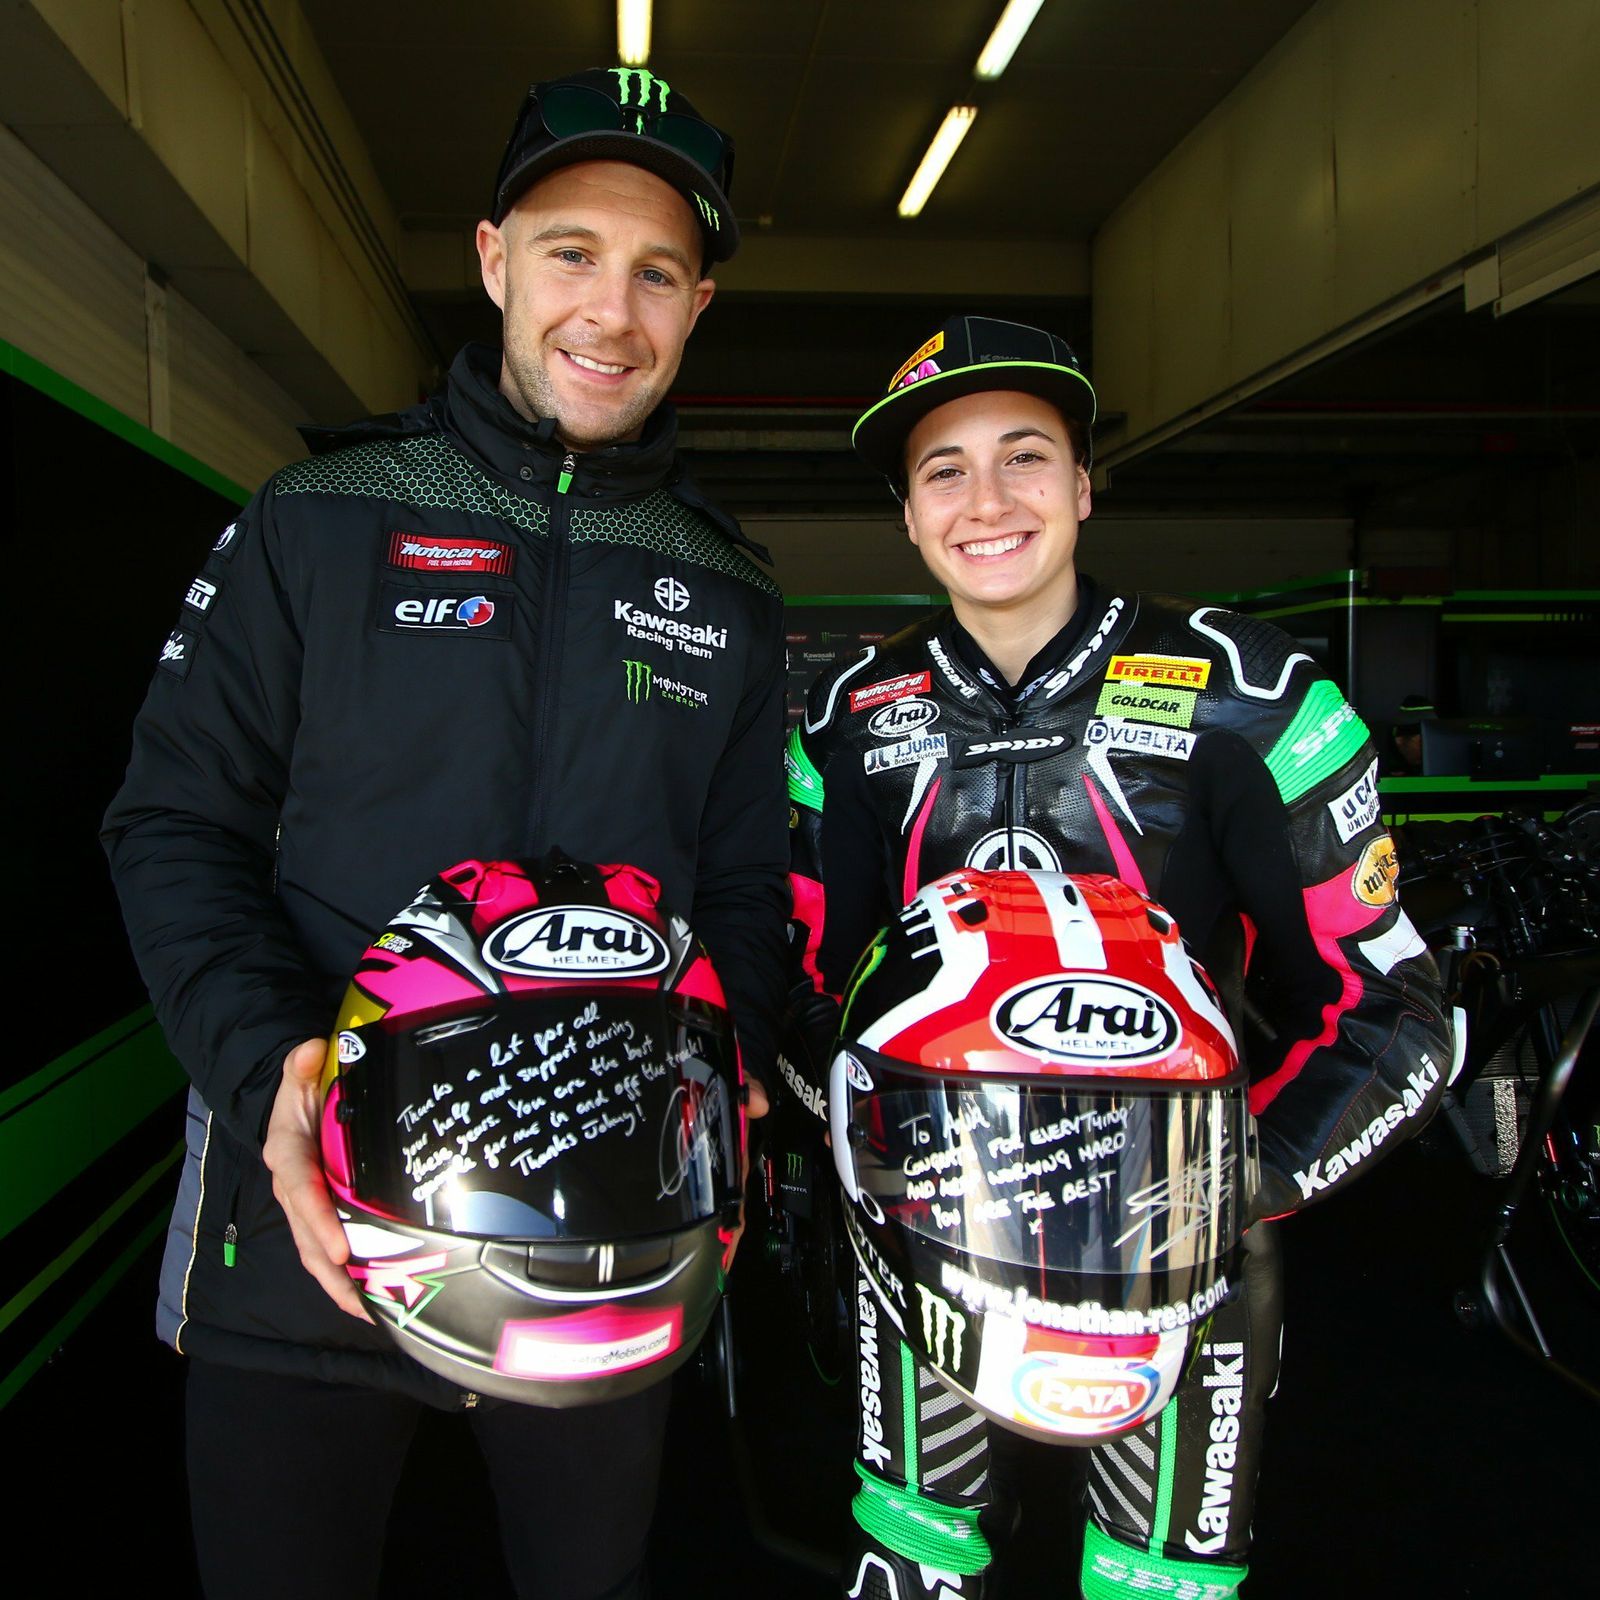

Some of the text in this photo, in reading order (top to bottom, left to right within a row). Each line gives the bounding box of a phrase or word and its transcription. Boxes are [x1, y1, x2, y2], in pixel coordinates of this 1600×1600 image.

[394, 598, 458, 625] elf
[613, 599, 728, 649] Kawasaki
[626, 623, 713, 660] Racing Team
[1112, 660, 1204, 683] PIRELLI
[652, 674, 709, 706] MONSTER
[1111, 694, 1181, 714] GOLDCAR
[872, 701, 930, 727] Arai
[964, 735, 1066, 757] SPIDI
[500, 913, 650, 963] Arai
[552, 955, 620, 966] HELMET
[573, 1000, 601, 1030] all
[1008, 987, 1162, 1039] Arai
[1060, 1039, 1129, 1050] HELMET
[479, 1073, 513, 1105] and
[516, 1035, 578, 1083] support
[585, 1020, 635, 1050] during
[775, 1052, 828, 1123] wasak
[1292, 1052, 1441, 1201] Kawasaki
[509, 1131, 579, 1177] Thanks
[1184, 1341, 1244, 1556] Kawasaki
